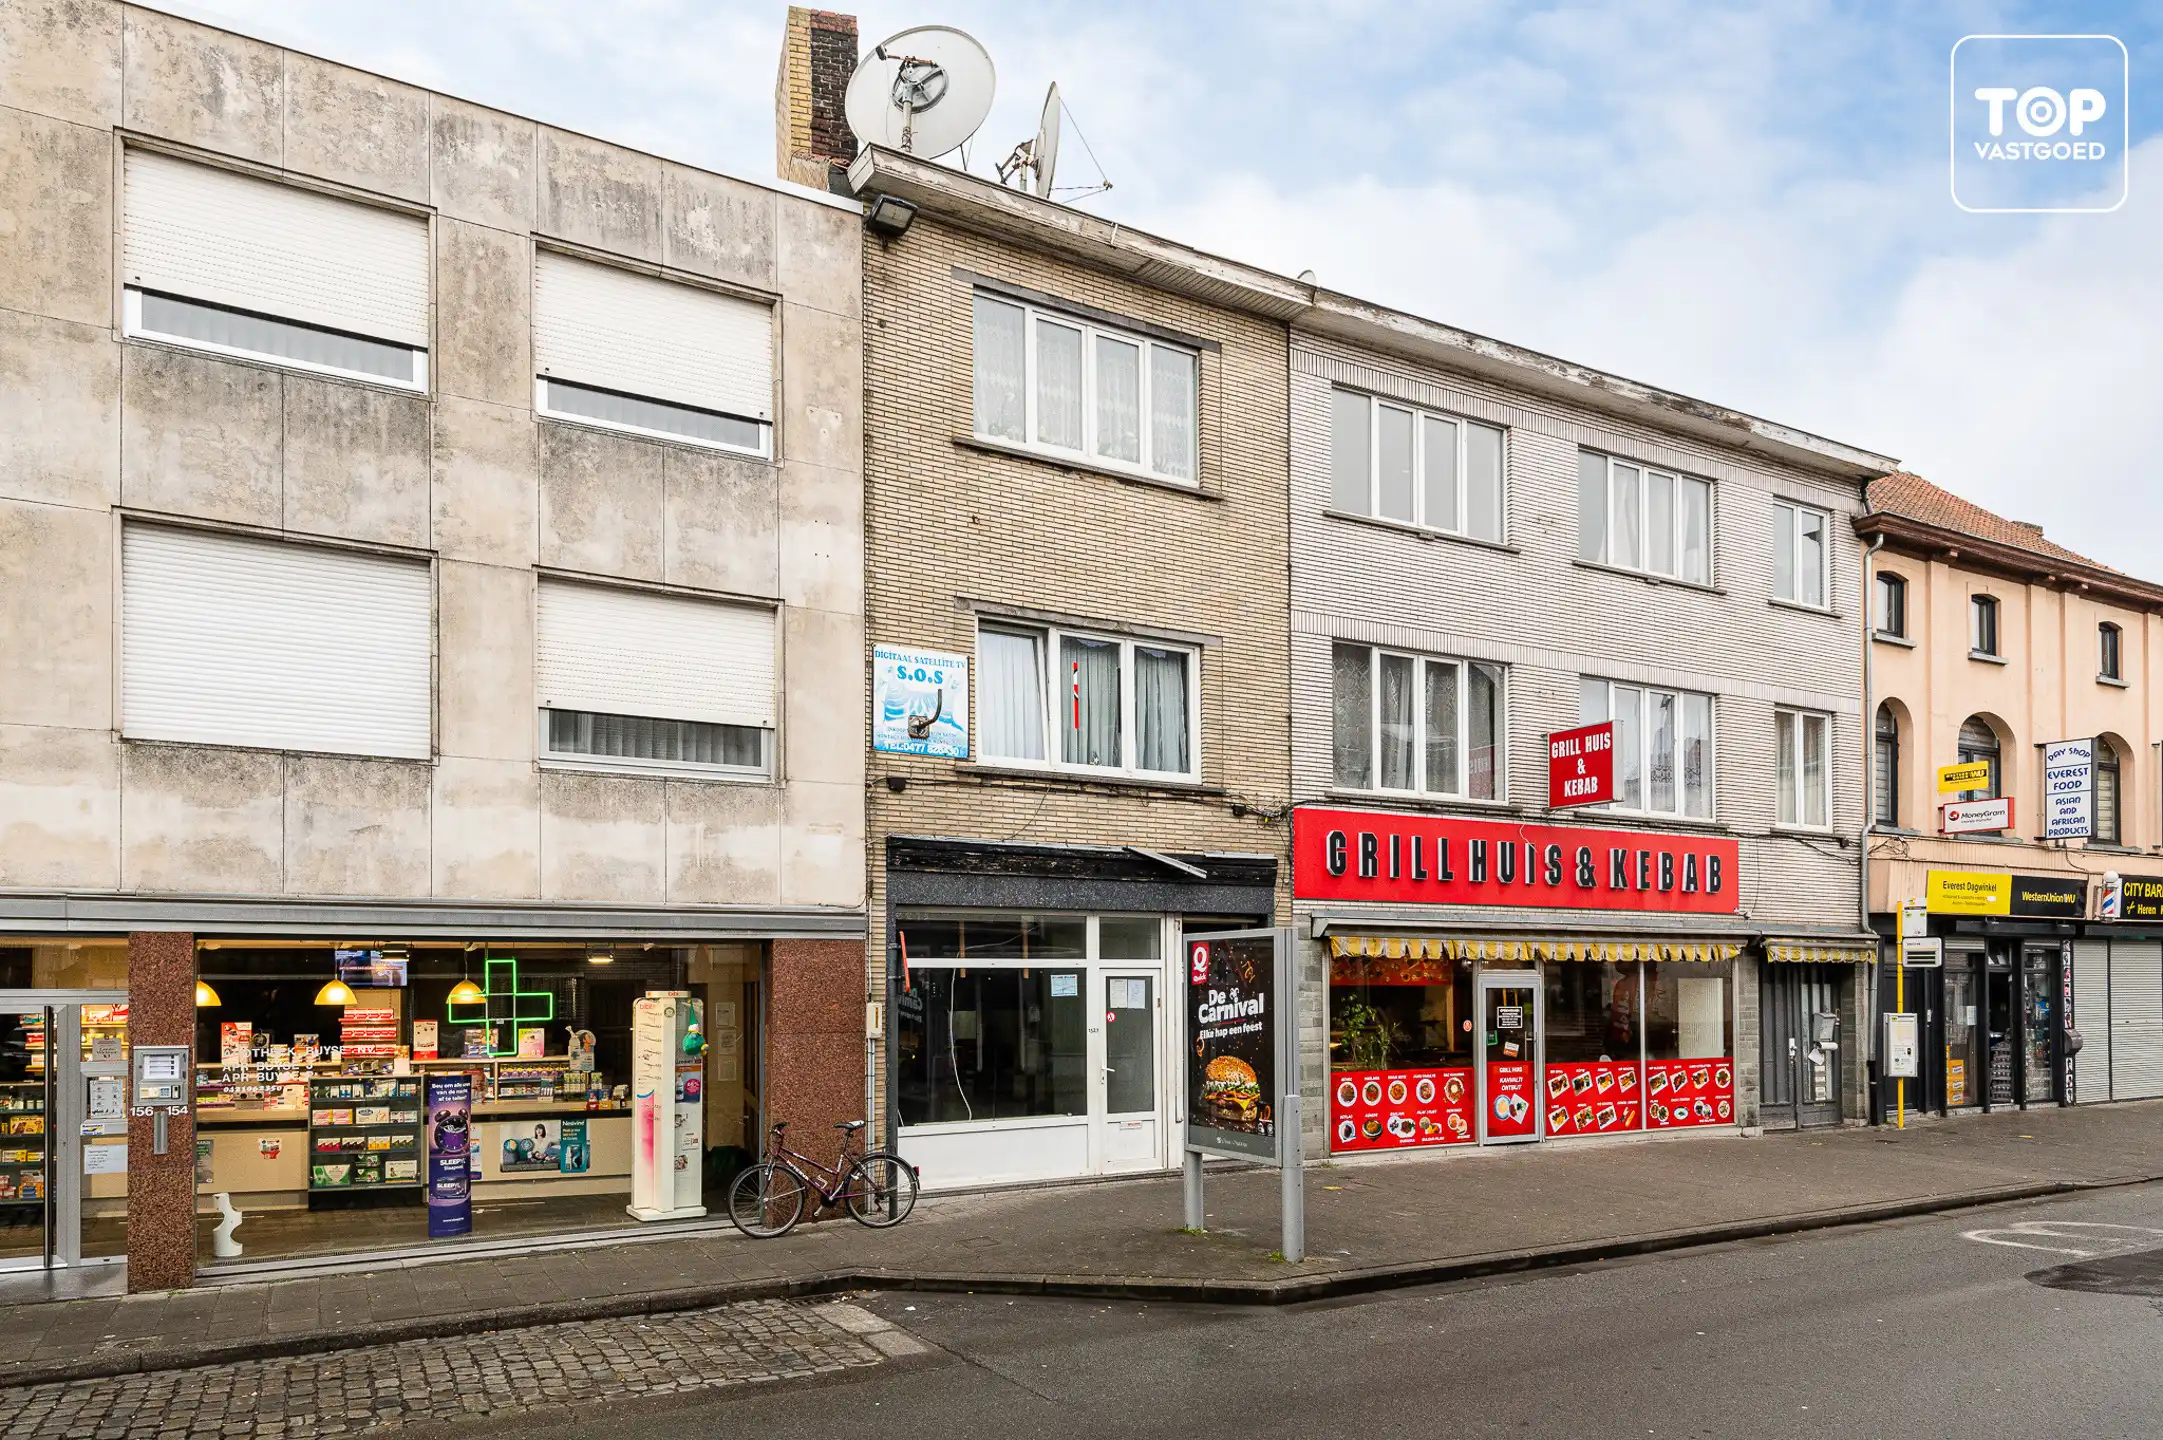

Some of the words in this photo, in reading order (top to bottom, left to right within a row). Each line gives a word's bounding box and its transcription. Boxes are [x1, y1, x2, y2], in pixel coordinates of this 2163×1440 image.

[897, 665, 944, 685] S.O.S
[1551, 737, 1582, 759] GRILL
[1584, 731, 1611, 753] HUIS
[2047, 748, 2066, 761] DAY
[1577, 757, 1586, 775] &
[2047, 767, 2089, 779] EVEREST
[1563, 776, 1598, 798] KEBAB
[2053, 780, 2082, 791] FOOD
[2055, 796, 2081, 806] ASIAN
[1961, 808, 2007, 820] MoneyGram
[2059, 806, 2077, 815] AND
[2051, 816, 2085, 826] AFRICAN
[2048, 826, 2089, 837] PRODUCTS
[1326, 830, 1454, 882] GRILL
[1468, 839, 1563, 886] HUIS
[1575, 846, 1597, 888] &
[1609, 848, 1722, 894] KEBAB
[1942, 880, 1966, 891] Everest
[1967, 881, 1997, 894] Dagwinkel
[2123, 882, 2144, 897] CITY
[2137, 904, 2157, 915] Heren
[1192, 973, 1207, 982] Quick
[1208, 989, 1227, 1007] De
[1198, 992, 1264, 1025] Carnival
[1199, 1028, 1214, 1040] Elke
[1215, 1027, 1228, 1038] hap
[1229, 1025, 1242, 1035] een
[1242, 1021, 1263, 1034] feest
[306, 1044, 347, 1057] BUYSE
[222, 1062, 250, 1072] APR
[222, 1072, 250, 1083] APR
[129, 1106, 154, 1117] 156
[165, 1105, 188, 1116] 154
